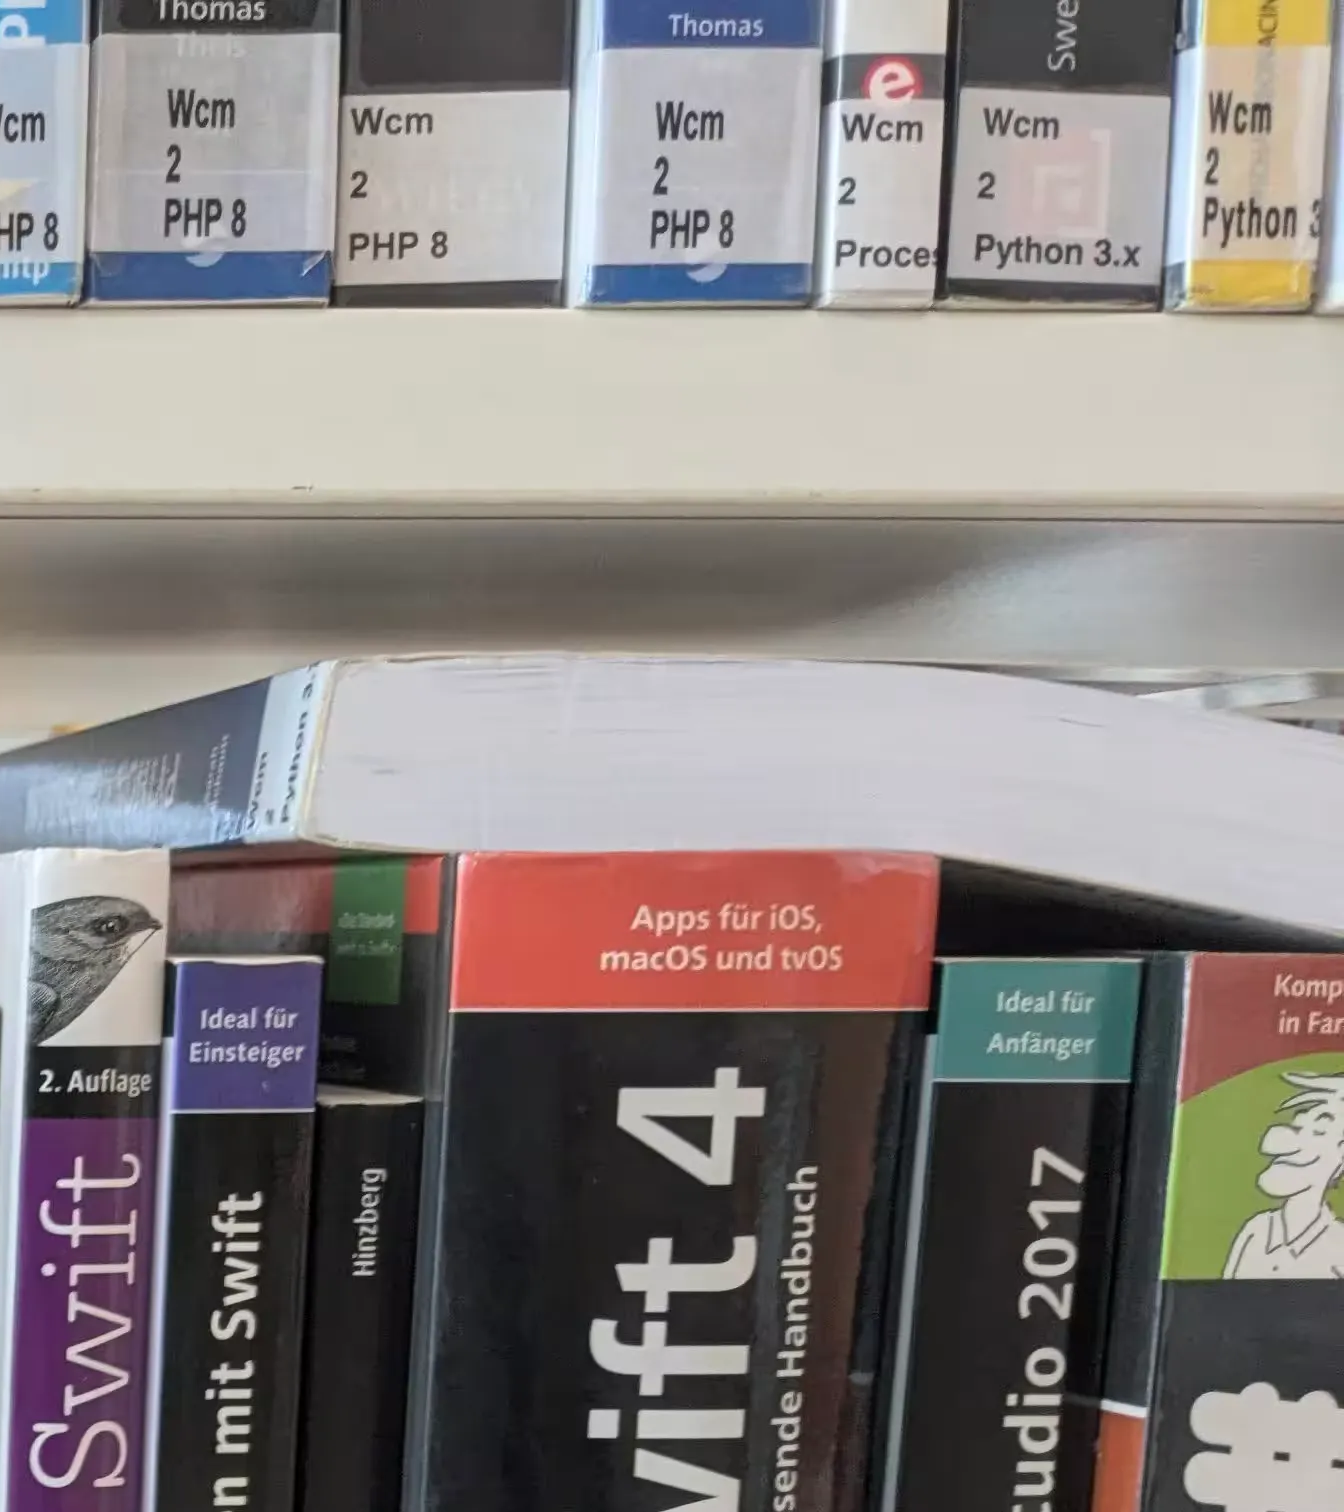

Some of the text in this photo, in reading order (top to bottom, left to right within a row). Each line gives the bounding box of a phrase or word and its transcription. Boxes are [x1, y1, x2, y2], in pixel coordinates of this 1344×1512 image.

[668, 13, 764, 37] Thomas
[43, 212, 60, 252] 8
[974, 234, 1141, 268] Python 3.x
[630, 902, 824, 937] Apps für iOS,
[599, 943, 843, 971] macOS und tvOS
[996, 990, 1096, 1014] Ideal für
[199, 1008, 297, 1031] Ideal für
[188, 1040, 306, 1067] Einsteiger
[986, 1031, 1096, 1059] Anfänger
[38, 1068, 152, 1099] 2. Auflage
[616, 1065, 767, 1188] 4
[351, 1167, 387, 1279] Hinzberg
[1018, 1145, 1088, 1320] 2017
[210, 1189, 264, 1339] Swift
[28, 1151, 144, 1489] Swift
[205, 1365, 255, 1464] mit
